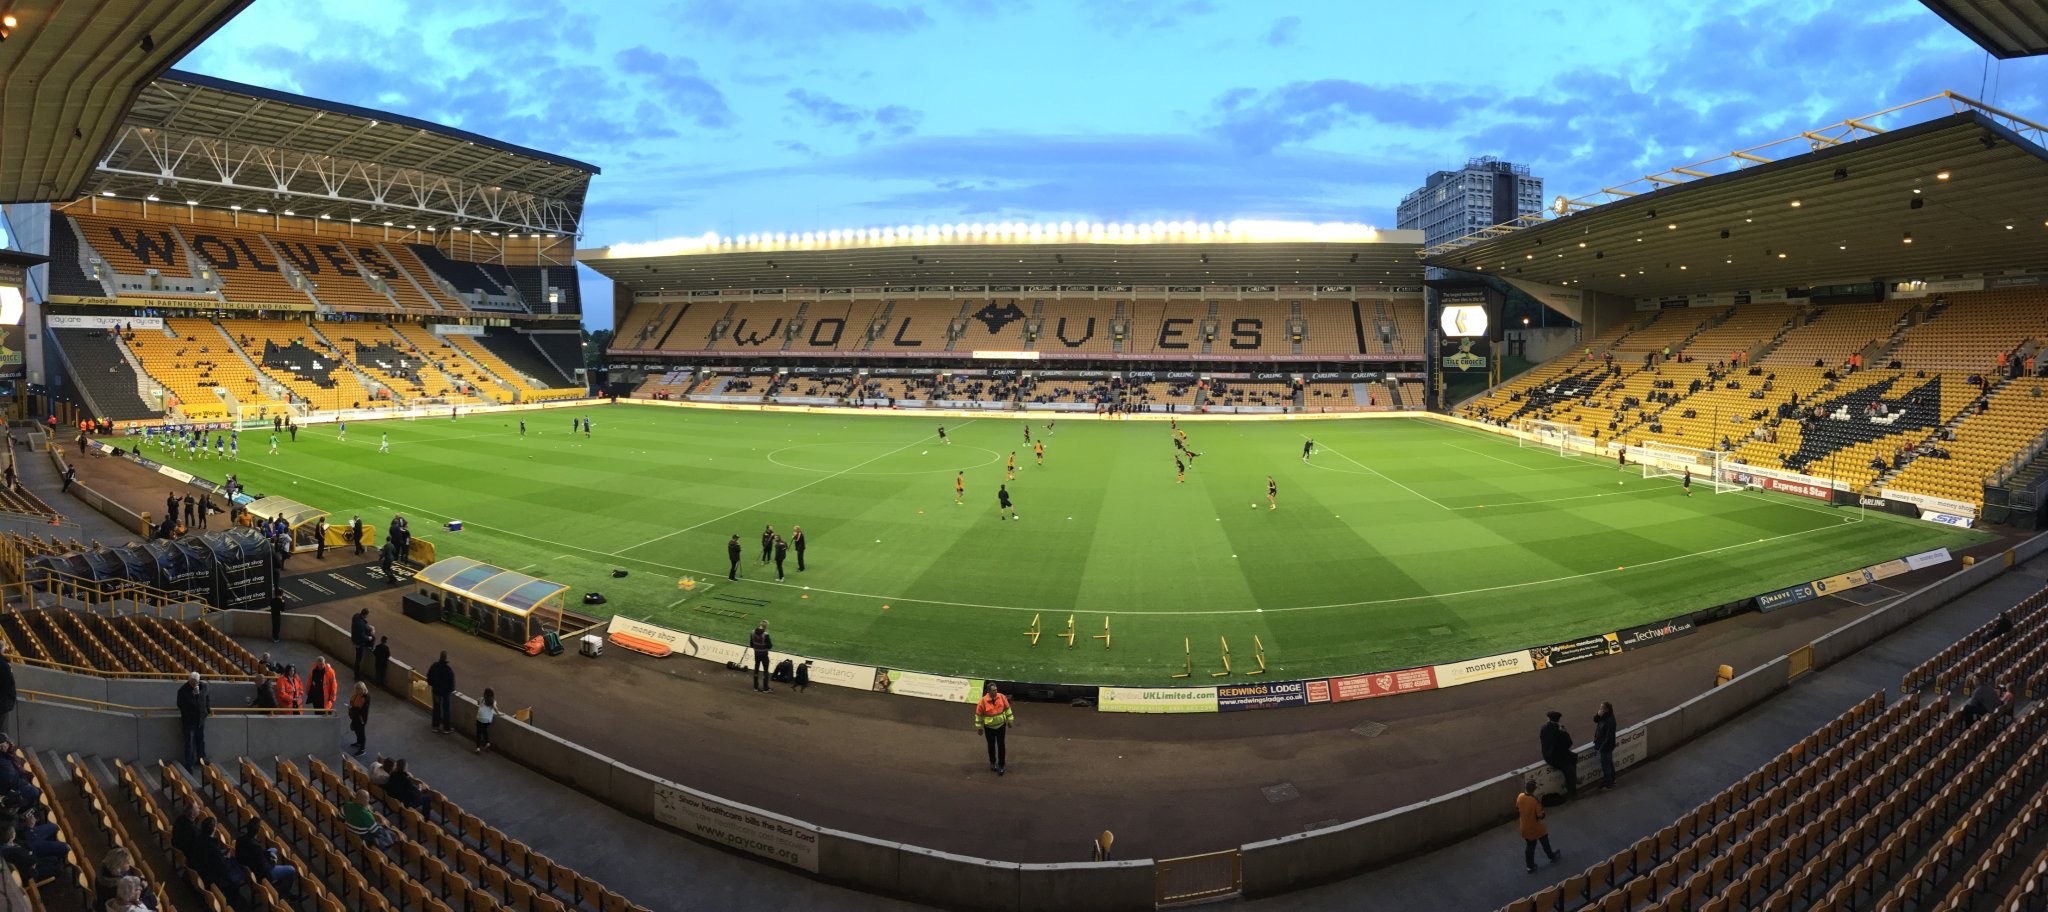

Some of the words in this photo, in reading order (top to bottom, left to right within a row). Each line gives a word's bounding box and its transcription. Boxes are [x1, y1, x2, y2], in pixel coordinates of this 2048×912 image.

[108, 226, 399, 280] WOLVES
[153, 300, 212, 308] PARTNERSHIP
[1312, 372, 1339, 380] CARLING
[1738, 474, 1750, 484] sky
[1753, 475, 1766, 486] BET
[1772, 480, 1802, 493] Express
[1809, 487, 1827, 498] Star
[1860, 497, 1885, 507] CARLING
[1892, 493, 1909, 502] money
[1910, 495, 1924, 503] shop
[1937, 500, 1957, 510] money
[1958, 503, 1973, 512] shop
[250, 559, 263, 567] shop
[252, 575, 265, 583] shop
[252, 590, 266, 599] shop
[630, 624, 657, 639] money
[658, 630, 677, 644] shop
[1465, 660, 1496, 674] money
[1497, 656, 1519, 670] shop
[1219, 686, 1268, 698] REDWINGS
[1270, 683, 1302, 694] LODGE
[1219, 693, 1303, 706] www.redwingslodge.co.uk
[1620, 735, 1632, 746] Red
[1632, 730, 1645, 741] Card
[678, 794, 700, 808] Show
[701, 801, 743, 822] healthcare
[744, 814, 761, 828] bills
[762, 819, 775, 832] the
[776, 824, 793, 837] Red
[795, 828, 816, 844] Card
[696, 822, 799, 864] www.paycare.org
